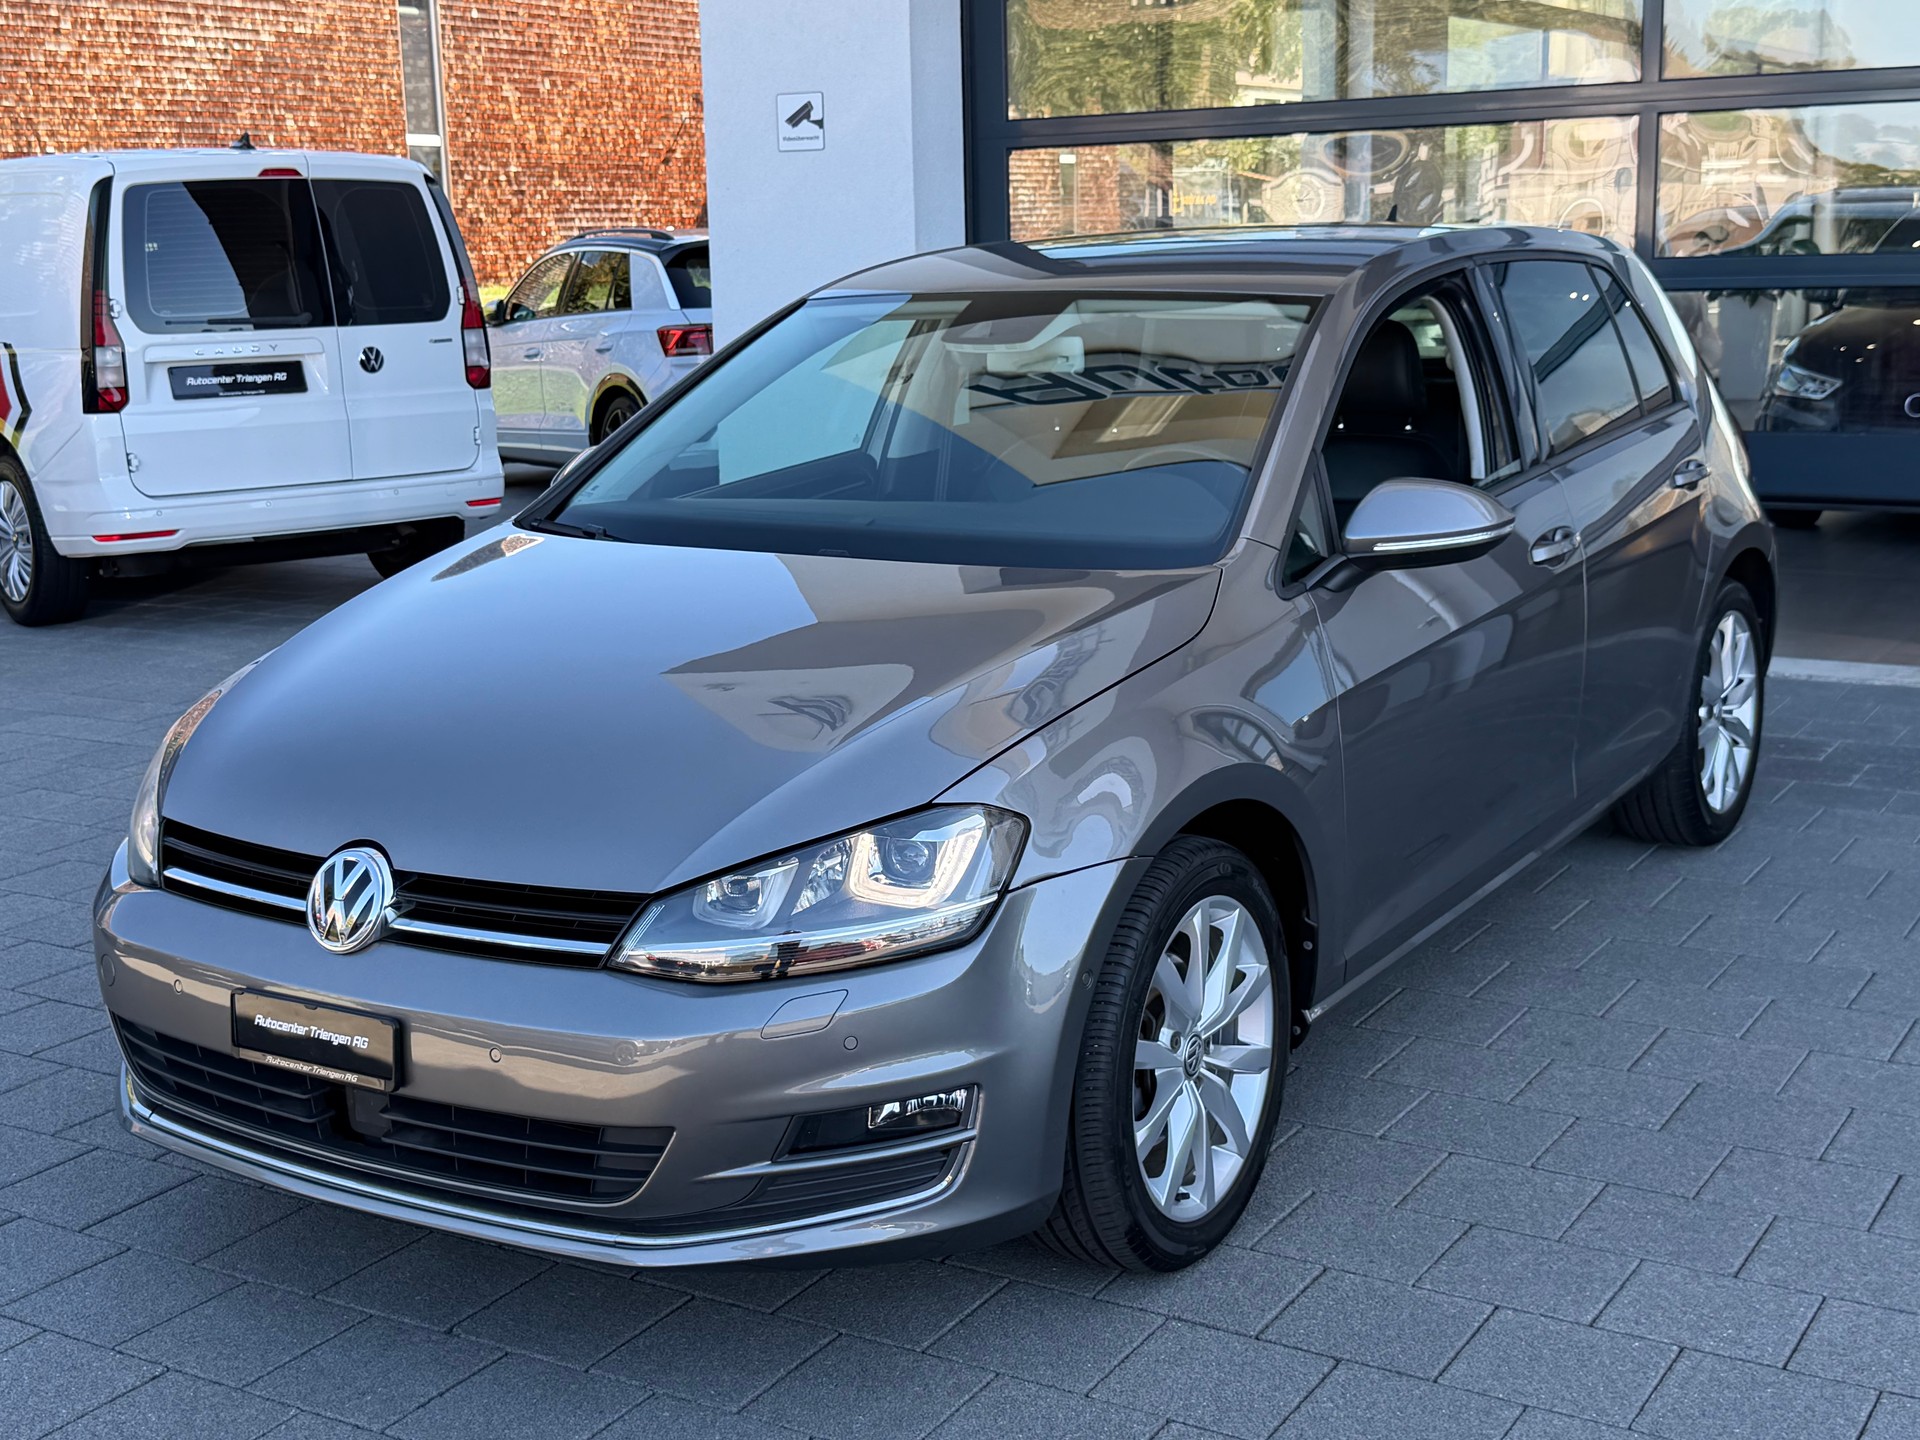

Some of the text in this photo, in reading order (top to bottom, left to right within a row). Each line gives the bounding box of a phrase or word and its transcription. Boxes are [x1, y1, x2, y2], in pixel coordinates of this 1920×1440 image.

[186, 375, 236, 386] Autocenter
[274, 371, 287, 381] AG
[254, 1013, 369, 1049] Autocenter Triengen AG
[265, 1055, 359, 1082] Autocenter Triengen AG
